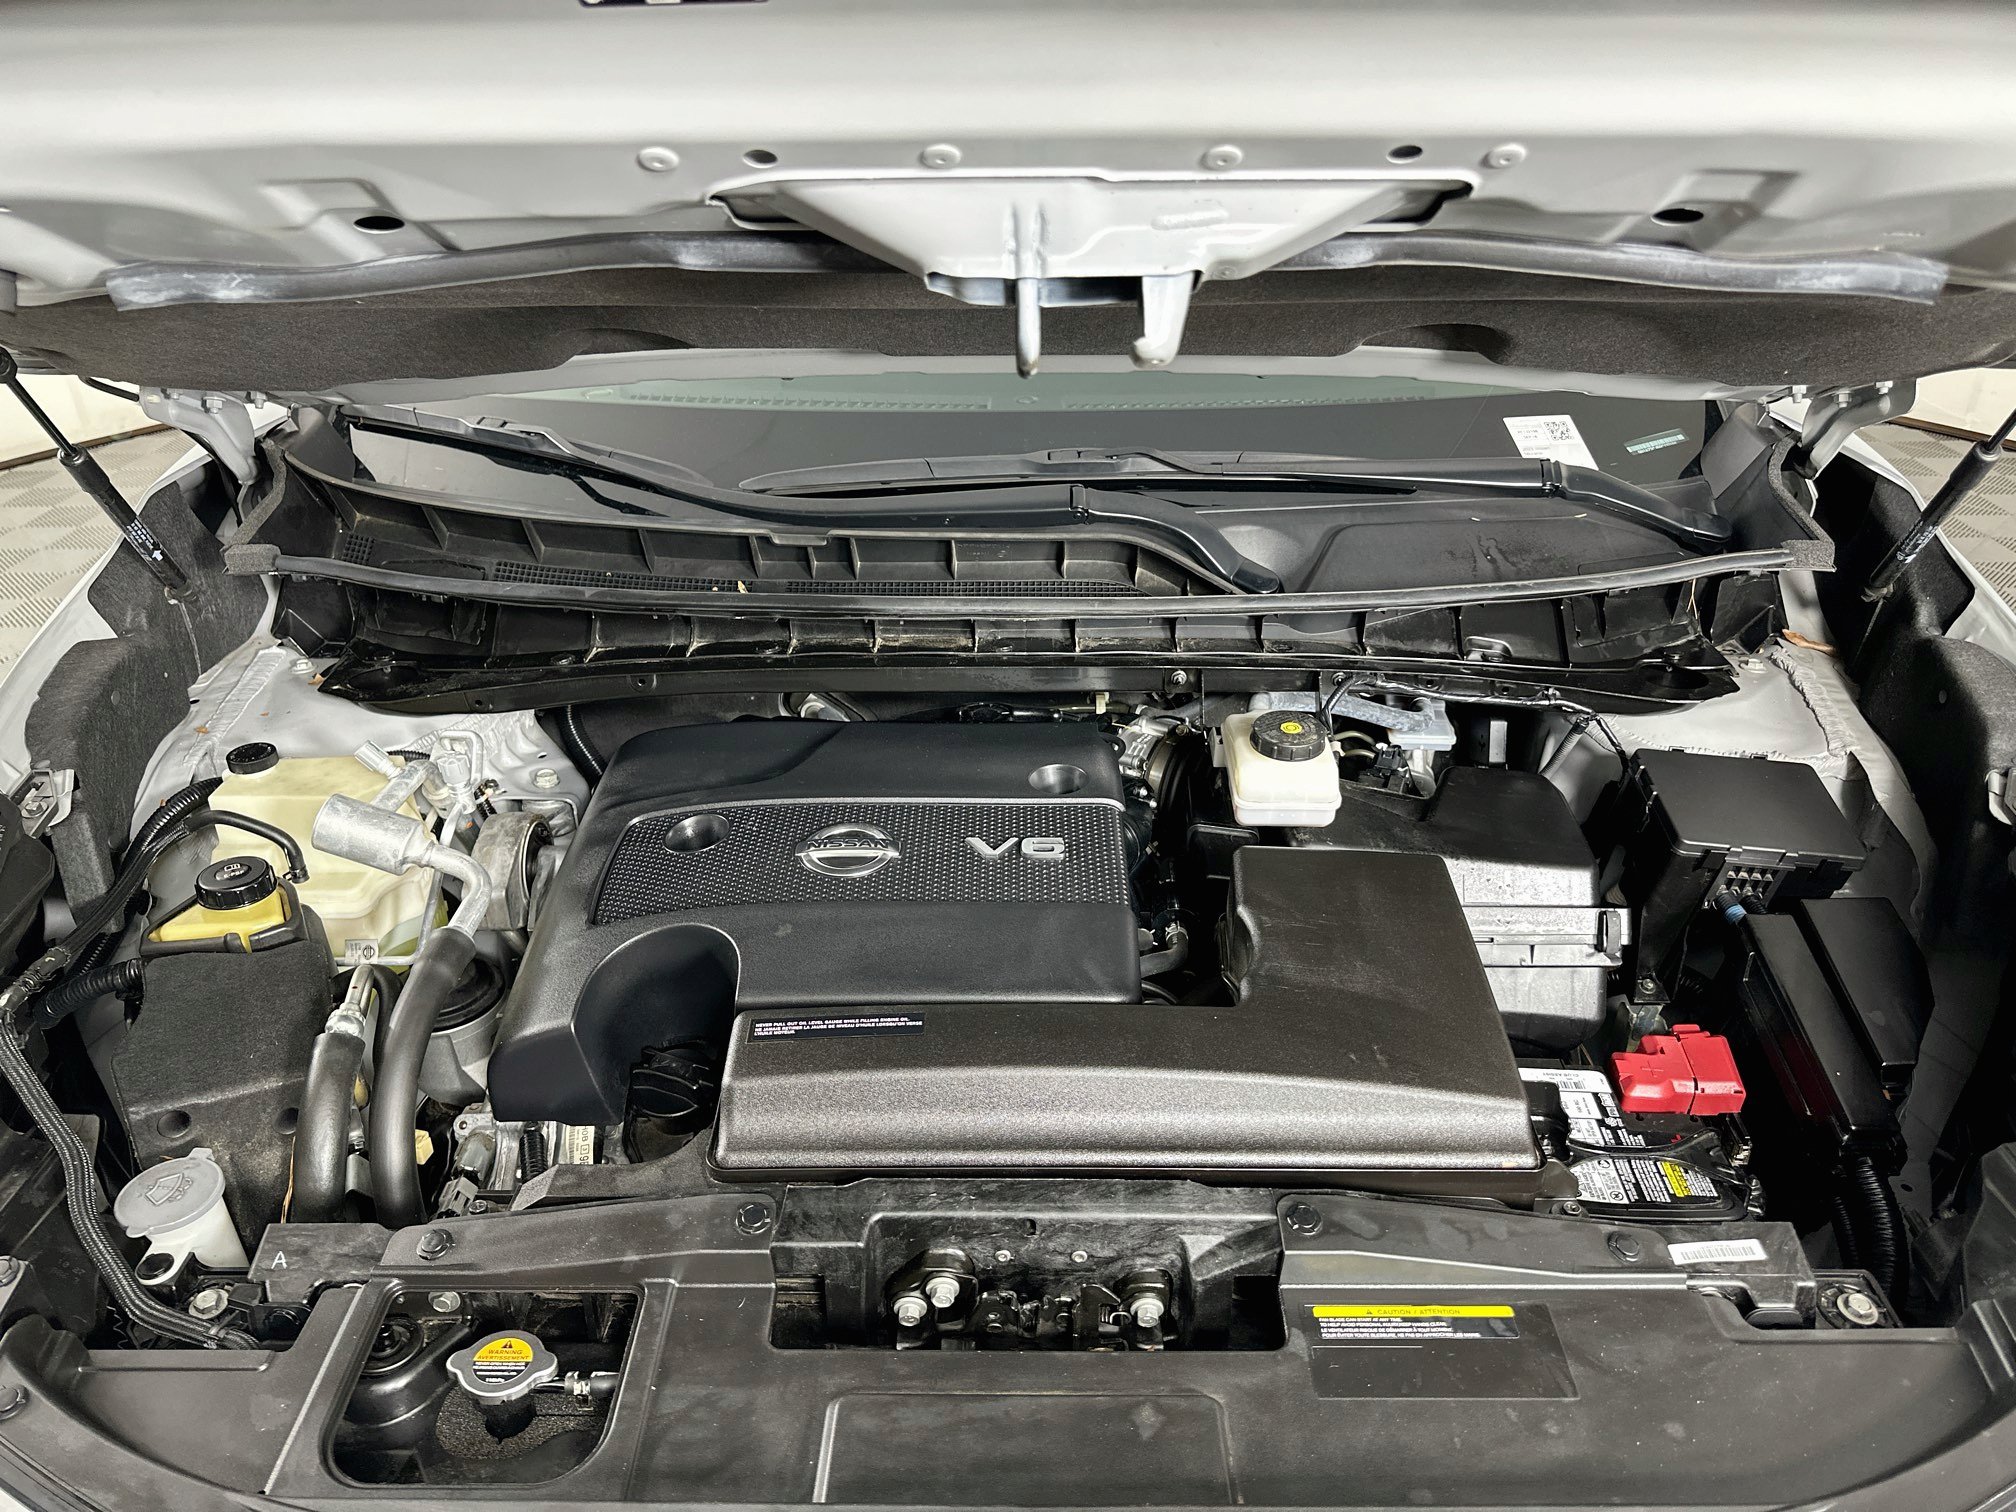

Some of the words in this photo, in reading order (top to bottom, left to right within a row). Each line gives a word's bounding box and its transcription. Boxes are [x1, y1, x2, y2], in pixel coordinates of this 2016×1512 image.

[806, 838, 889, 849] NISSAN
[964, 837, 1065, 860] V6
[271, 1251, 287, 1269] A
